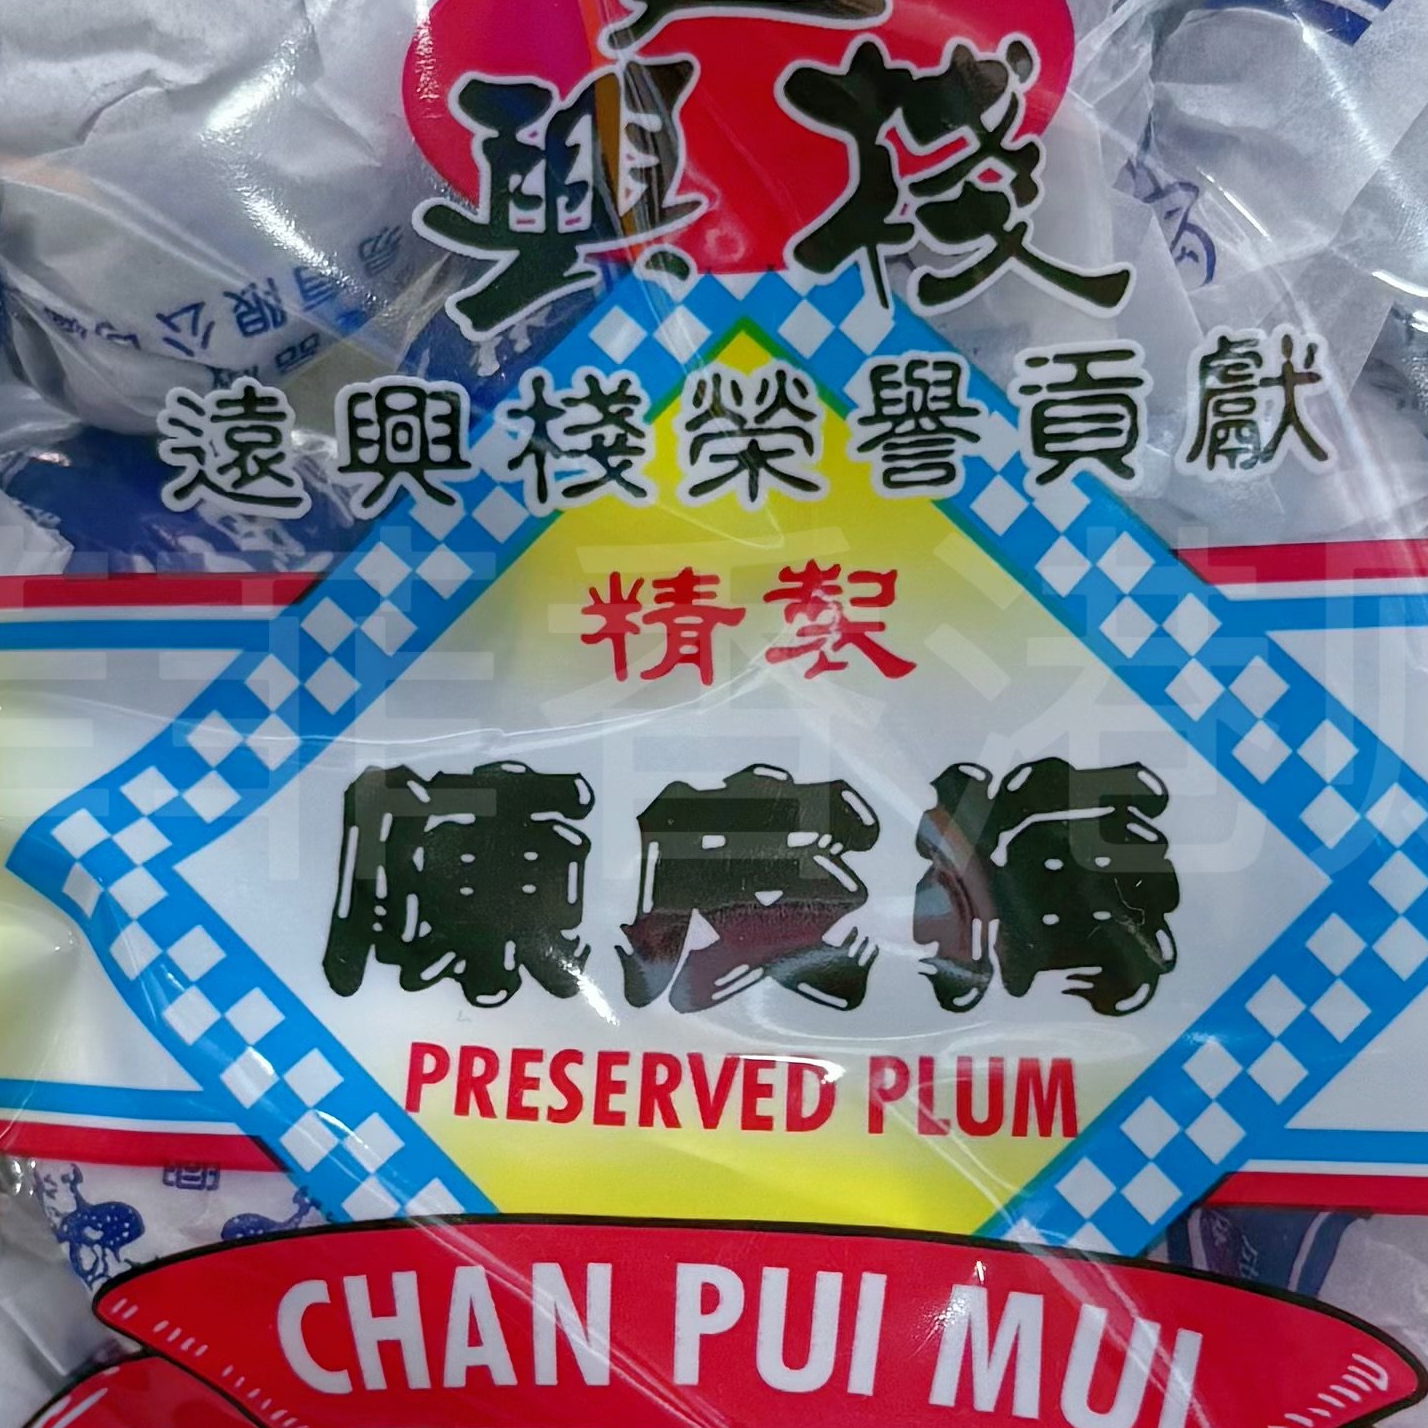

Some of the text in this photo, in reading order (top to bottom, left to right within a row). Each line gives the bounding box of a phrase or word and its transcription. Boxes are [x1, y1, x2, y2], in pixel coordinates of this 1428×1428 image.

[162, 330, 1338, 516] 遠興棧榮譽貢獻
[405, 1042, 1078, 1139] PRESERVED PLUM
[277, 1262, 613, 1395] CHAN
[674, 1262, 886, 1397] PUI
